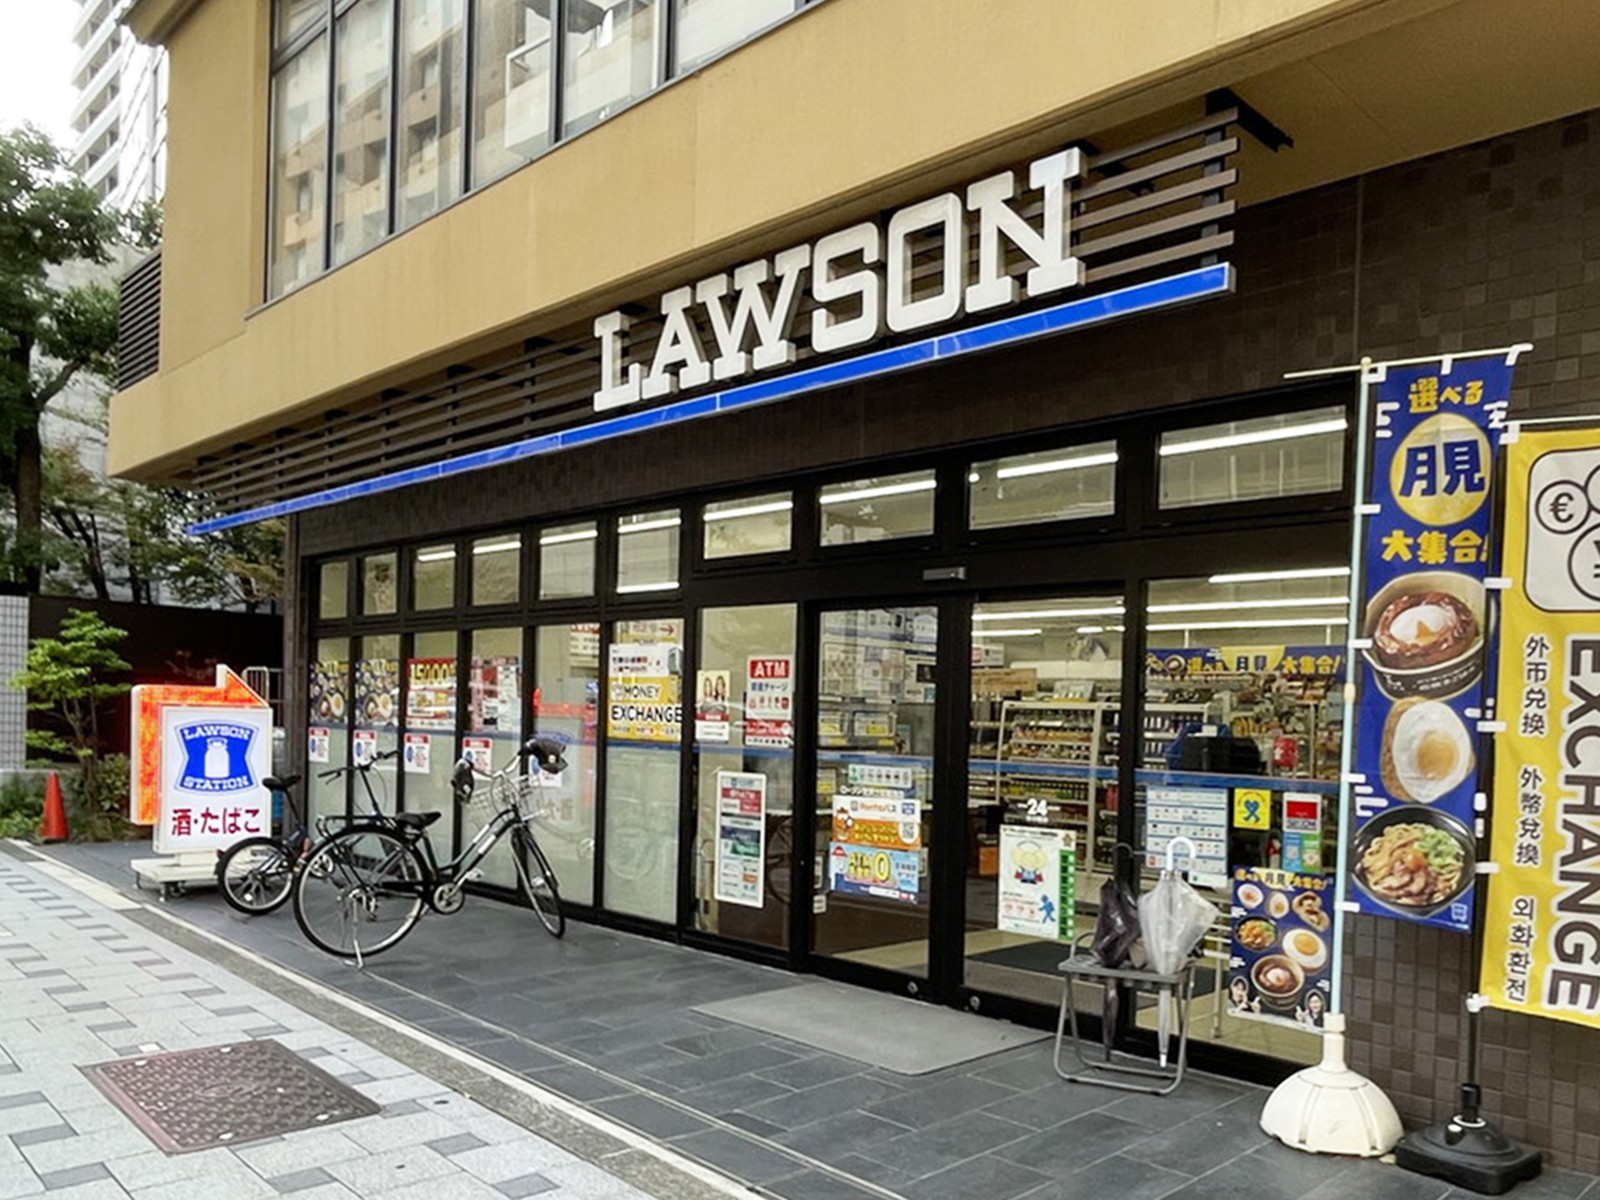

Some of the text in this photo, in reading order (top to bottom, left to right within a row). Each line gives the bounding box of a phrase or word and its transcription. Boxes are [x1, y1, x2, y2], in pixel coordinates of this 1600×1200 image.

[594, 146, 1086, 412] LAWSON
[1408, 376, 1483, 414] 選べる
[1398, 439, 1486, 498] 月見
[754, 660, 786, 678] ATM
[623, 685, 661, 698] MONEY
[611, 705, 683, 723] EXCHANGE
[183, 725, 252, 741] LAWSON
[183, 775, 250, 791] STATION
[1506, 897, 1534, 1003] 외화환전
